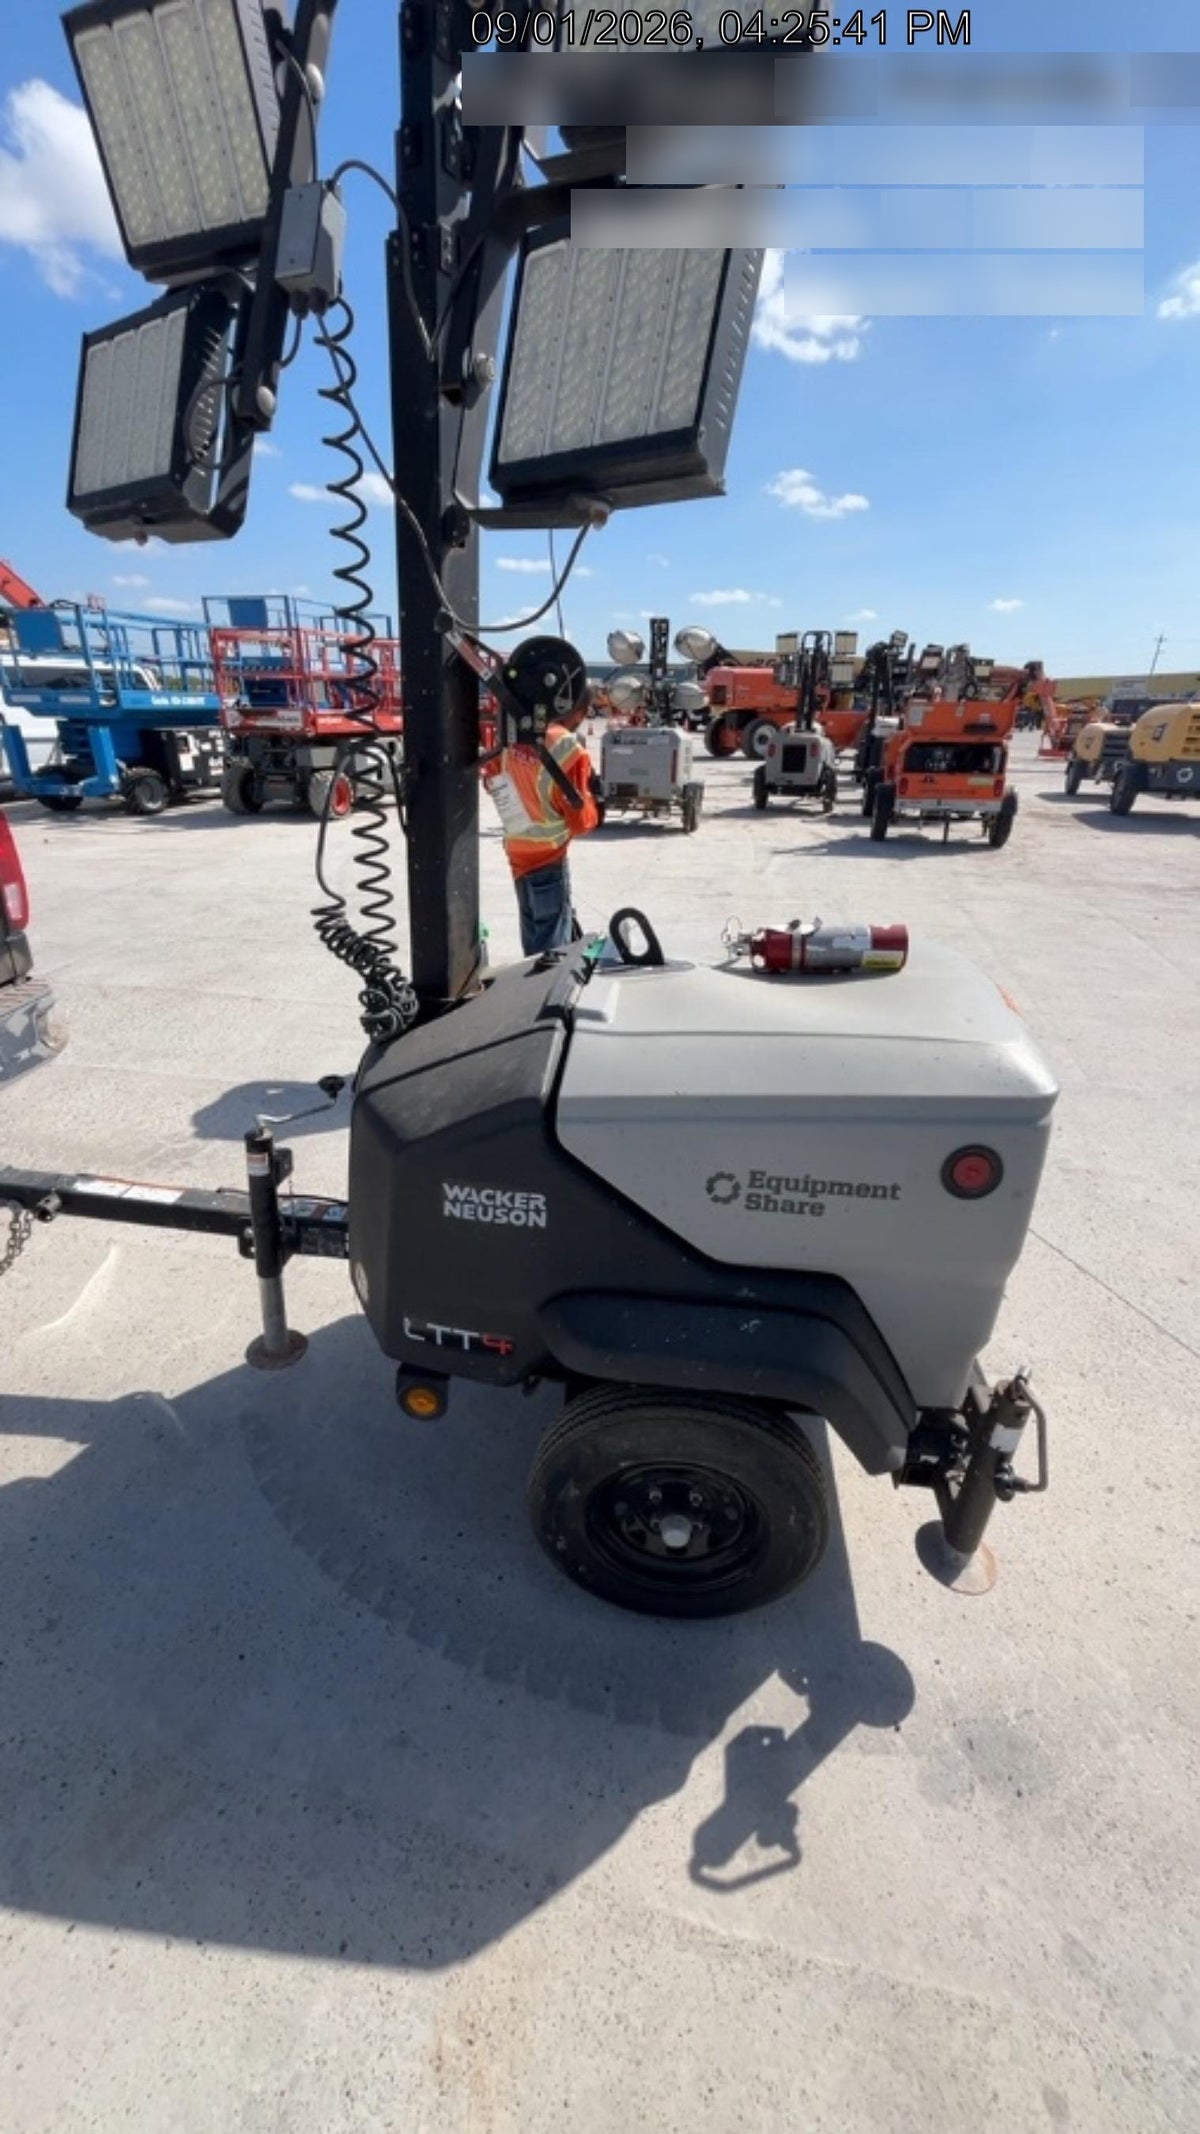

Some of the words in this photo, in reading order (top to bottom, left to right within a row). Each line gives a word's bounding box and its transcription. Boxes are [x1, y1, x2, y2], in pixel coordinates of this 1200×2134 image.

[442, 1182, 547, 1210] WACKER
[748, 1170, 901, 1200] Equipment
[443, 1202, 547, 1228] NEUSON
[744, 1192, 826, 1217] Share
[402, 1317, 513, 1356] LTT4
